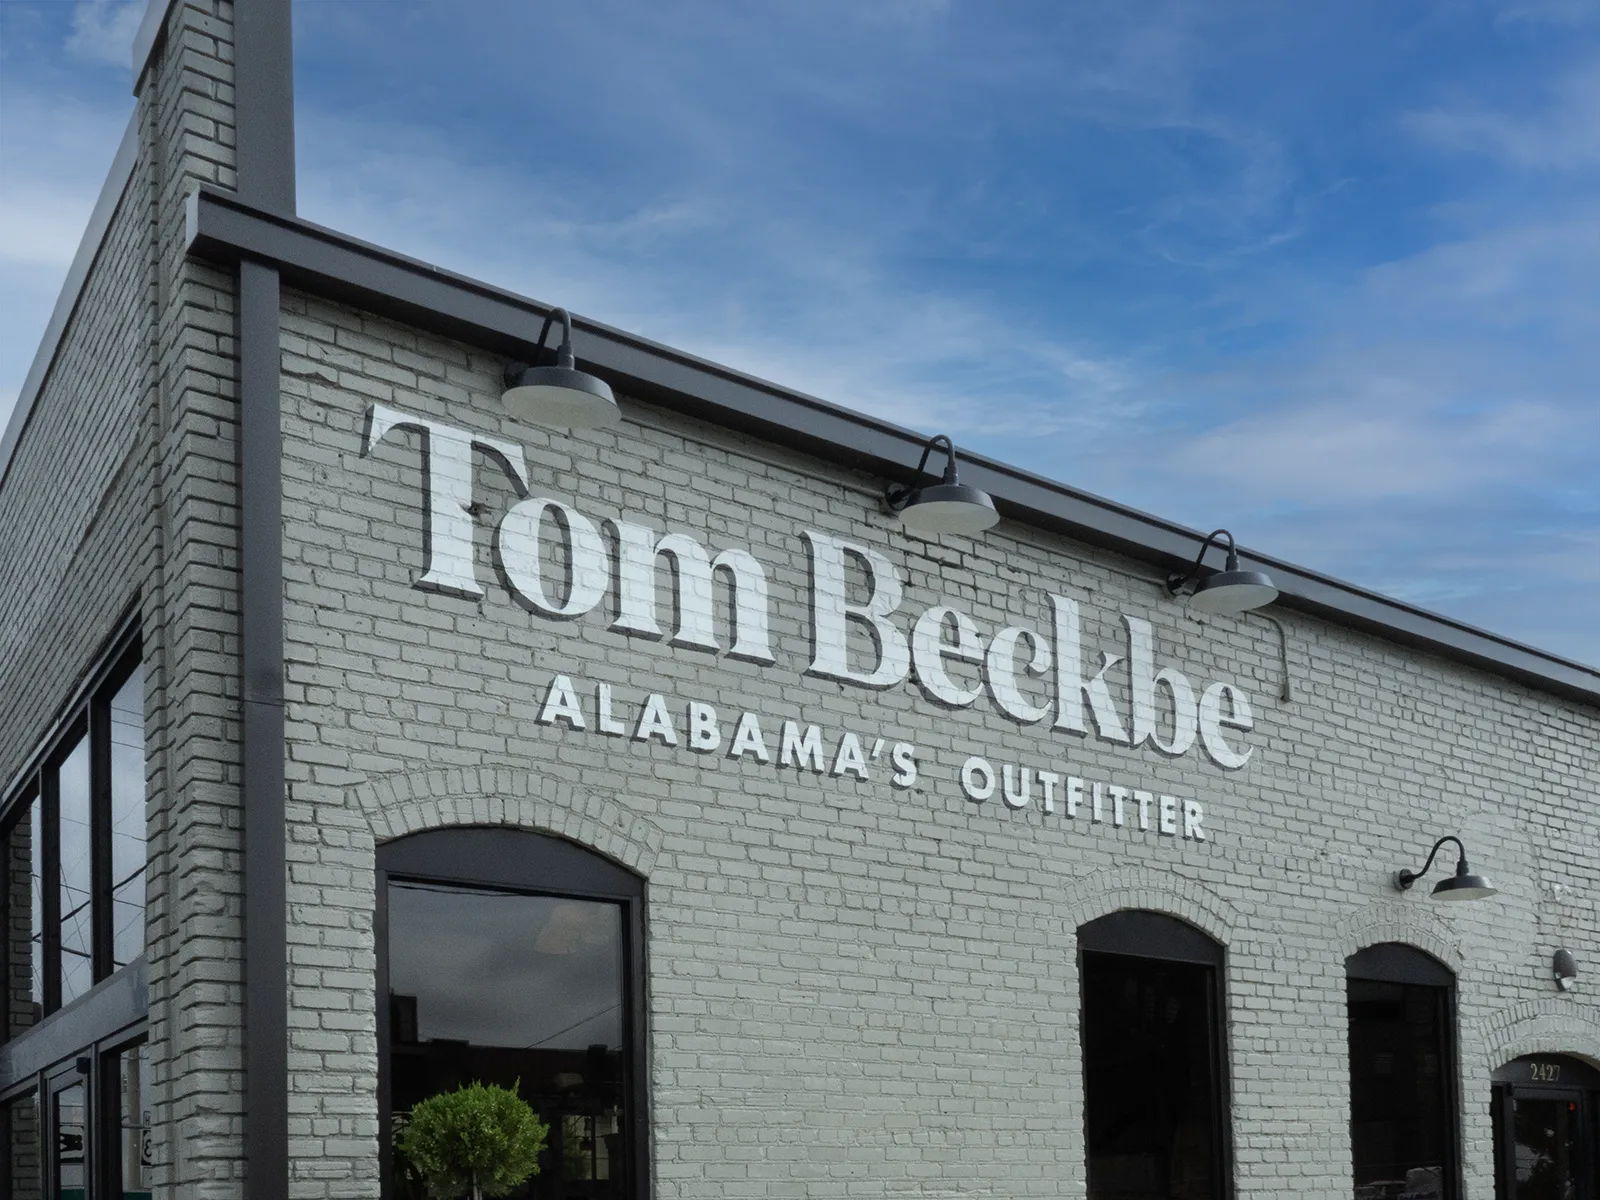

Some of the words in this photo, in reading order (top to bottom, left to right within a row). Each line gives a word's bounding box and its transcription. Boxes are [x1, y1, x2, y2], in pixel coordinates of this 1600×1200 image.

[361, 403, 776, 668] Tom
[801, 529, 1255, 771] Beckbe
[533, 673, 918, 788] ALABAMA'S
[960, 756, 1206, 843] OUTFITTER
[1530, 1063, 1561, 1082] 2427
